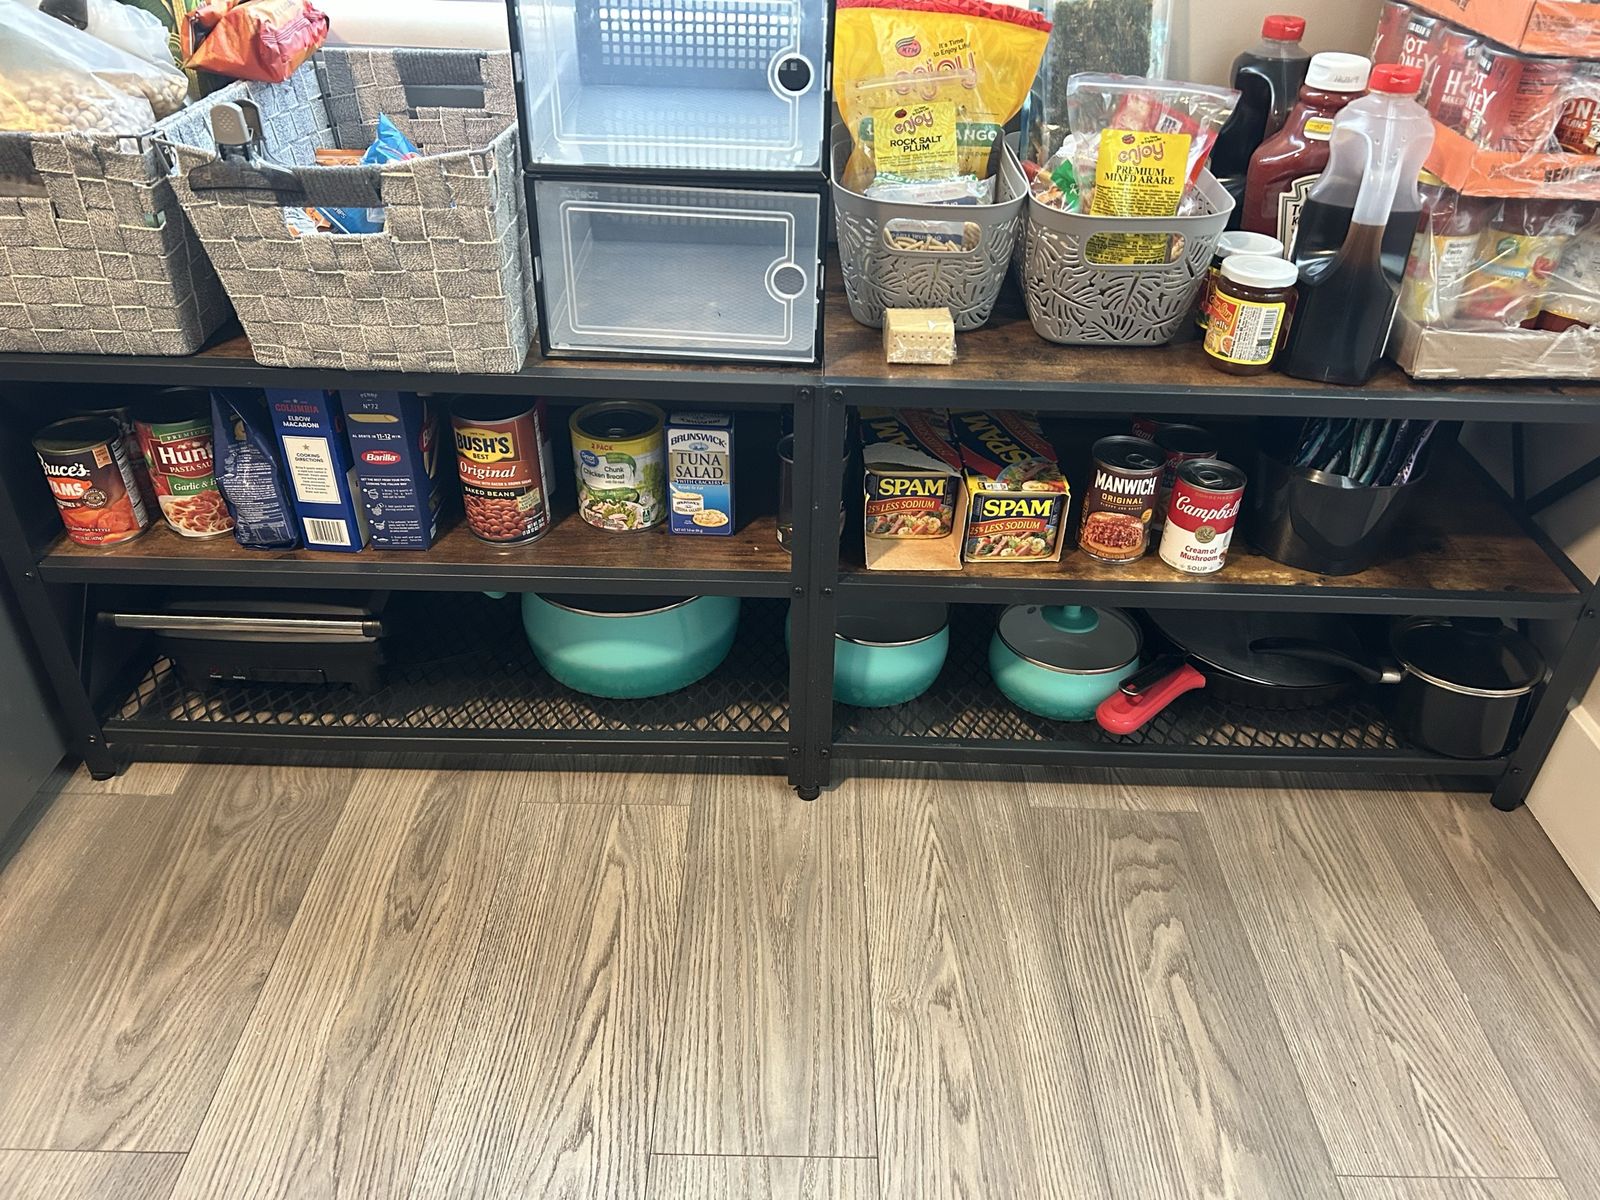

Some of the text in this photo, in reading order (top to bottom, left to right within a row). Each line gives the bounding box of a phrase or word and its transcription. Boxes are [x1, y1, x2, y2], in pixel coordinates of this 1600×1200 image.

[949, 38, 964, 47] Time
[940, 46, 958, 56] Enjoy
[894, 111, 934, 135] enjoy
[890, 135, 942, 148] ROCK SALT
[903, 144, 930, 152] PLUM
[1118, 143, 1164, 166] enjoy
[1116, 165, 1165, 176] PREMIUM
[1104, 172, 1137, 183] MIXED
[1138, 176, 1175, 185] ARARE
[275, 403, 319, 414] COLUMBIA
[166, 429, 206, 441] PREMIUM
[671, 433, 726, 448] BRUNSWICK
[961, 412, 1029, 464] SPAM
[456, 431, 511, 454] BUSH'S
[158, 446, 213, 465] Hunt
[366, 454, 396, 462] Barilla
[677, 452, 721, 466] TUNA
[38, 455, 90, 476] ruce's
[170, 460, 213, 473] PASTA SAU
[460, 461, 516, 479] Original
[675, 465, 723, 479] SALAD
[583, 468, 606, 479] Chicken
[174, 482, 200, 491] Garlic
[878, 478, 945, 496] SPAM
[1094, 469, 1157, 495] MANWICH
[464, 487, 515, 497] BAKED BEANS
[1101, 493, 1143, 504] ORIGINAL
[880, 501, 900, 512] LESS
[901, 500, 935, 509] SODIUM
[982, 499, 1053, 517] SPAM
[984, 522, 1005, 533] LESS
[1005, 521, 1040, 531] SODIUM
[1185, 545, 1209, 555] Cream
[1180, 552, 1218, 562] Mushroom
